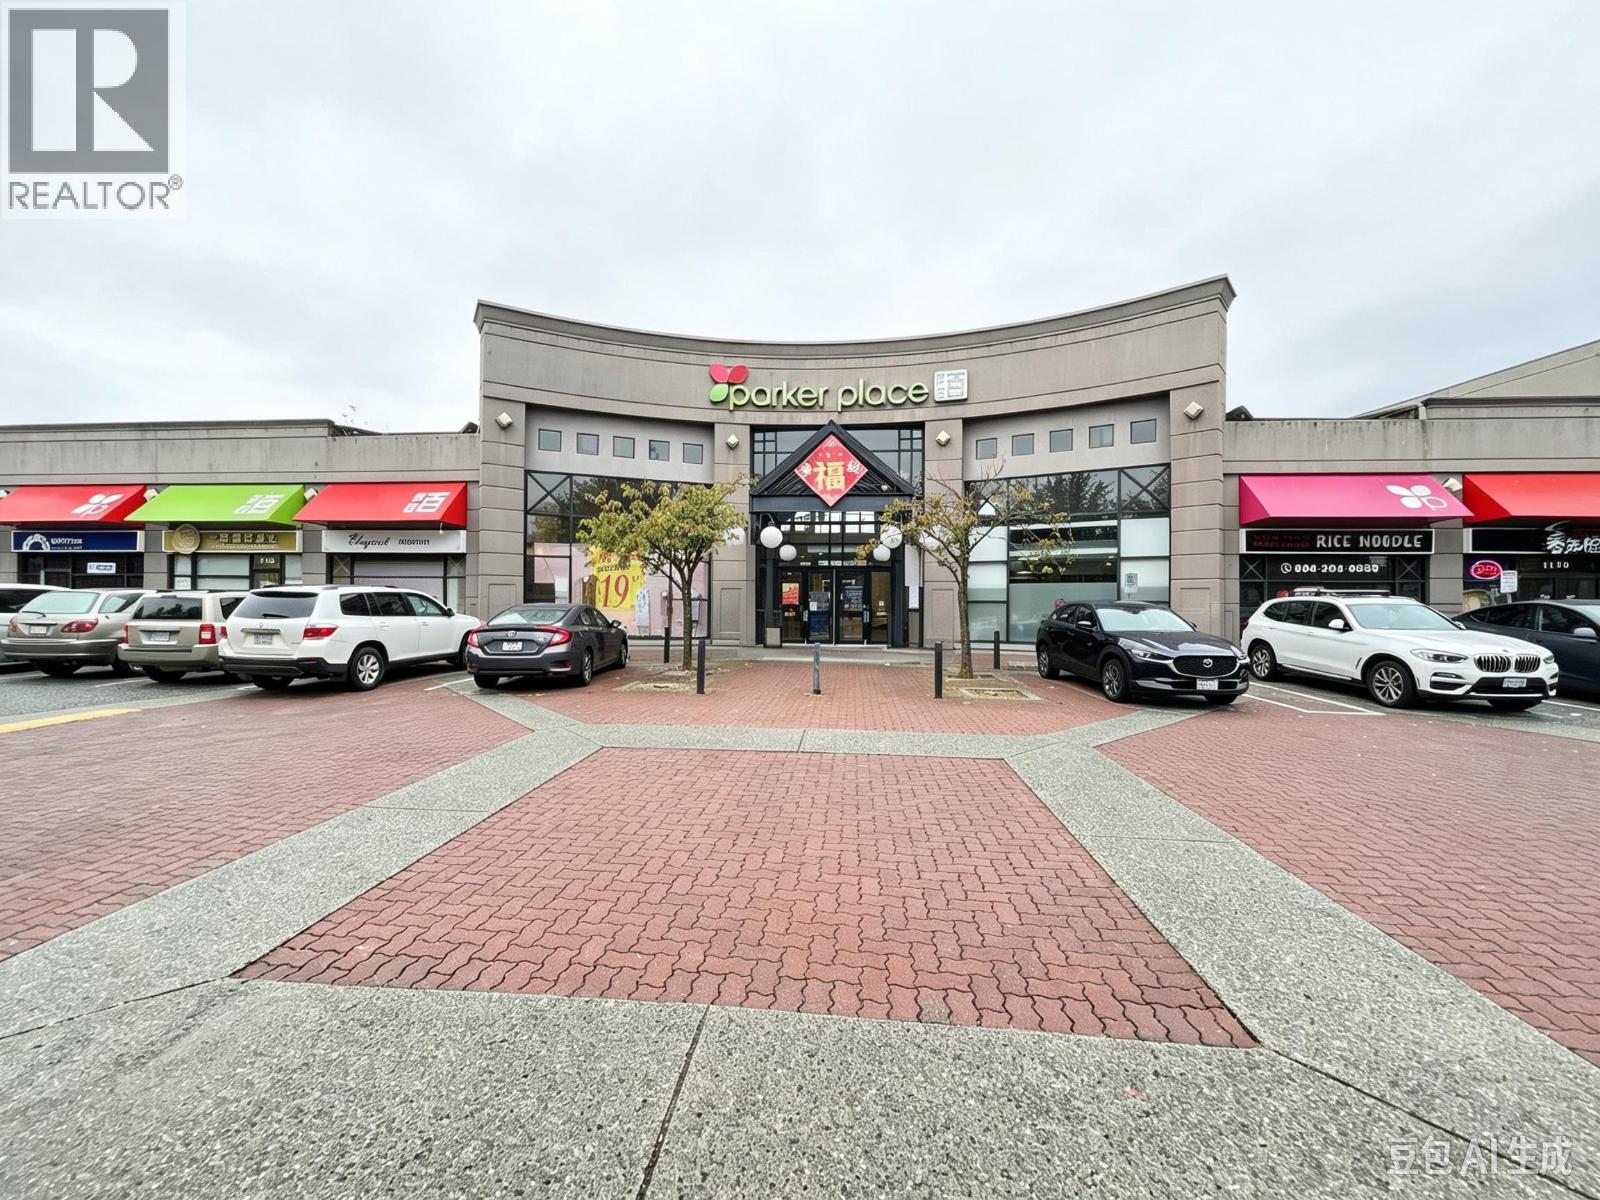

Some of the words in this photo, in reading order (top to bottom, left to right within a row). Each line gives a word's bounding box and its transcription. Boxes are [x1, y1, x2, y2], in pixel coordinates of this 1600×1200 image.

[728, 380, 829, 412] parker
[837, 378, 930, 413] place
[812, 461, 846, 491] 福
[1316, 535, 1351, 548] RICE
[1359, 535, 1424, 548] NOODLE
